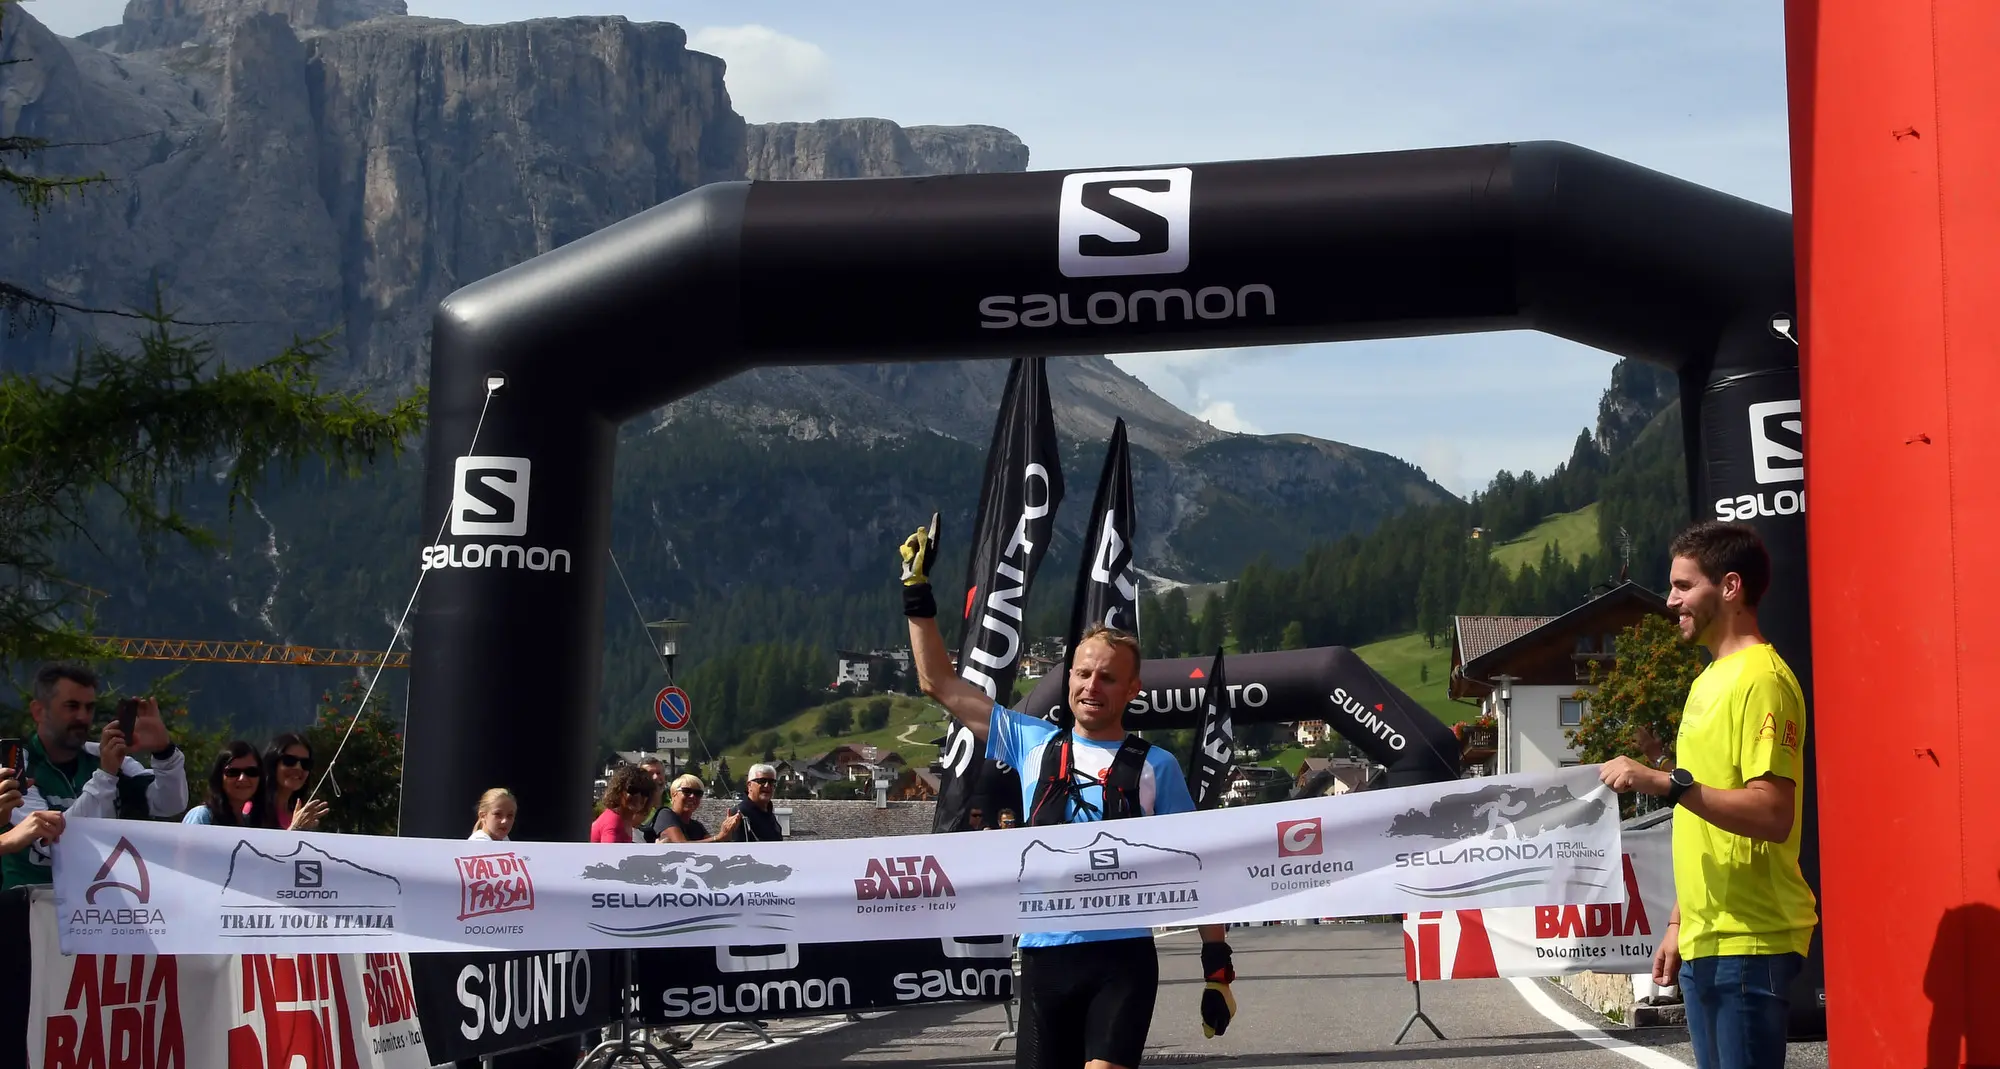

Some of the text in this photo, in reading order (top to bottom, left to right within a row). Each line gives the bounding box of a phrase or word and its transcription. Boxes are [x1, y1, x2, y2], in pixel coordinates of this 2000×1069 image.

[978, 283, 1276, 329] salomon
[421, 543, 571, 573] salomon
[1329, 687, 1406, 751] SUUNTO
[1395, 843, 1553, 868] SELLARONDA
[1556, 842, 1587, 850] TRAIL
[1556, 849, 1606, 859] RUNNING
[865, 855, 946, 878] ALTA
[1246, 860, 1354, 879] Val Gardena
[1074, 870, 1138, 883] salomon
[1271, 878, 1332, 891] Dolomites
[276, 889, 338, 899] salomon
[468, 876, 528, 912] FASSA
[854, 875, 956, 901] BADIA
[591, 892, 744, 908] SELLARONDA
[747, 897, 796, 906] RUNNING
[856, 901, 957, 914] Dolomites Italy
[1018, 888, 1199, 913] TRAIL TOUR ITALIA
[69, 908, 166, 925] ARABBA
[220, 914, 395, 929] TRAIL TOUR ITALIA
[1534, 902, 1652, 939] BADIA
[464, 925, 524, 935] DOLOMITES
[1535, 943, 1654, 959] Dolomites Italy
[456, 949, 592, 1041] SUUNTO
[662, 976, 851, 1018] salomon
[407, 1026, 423, 1046] Ita
